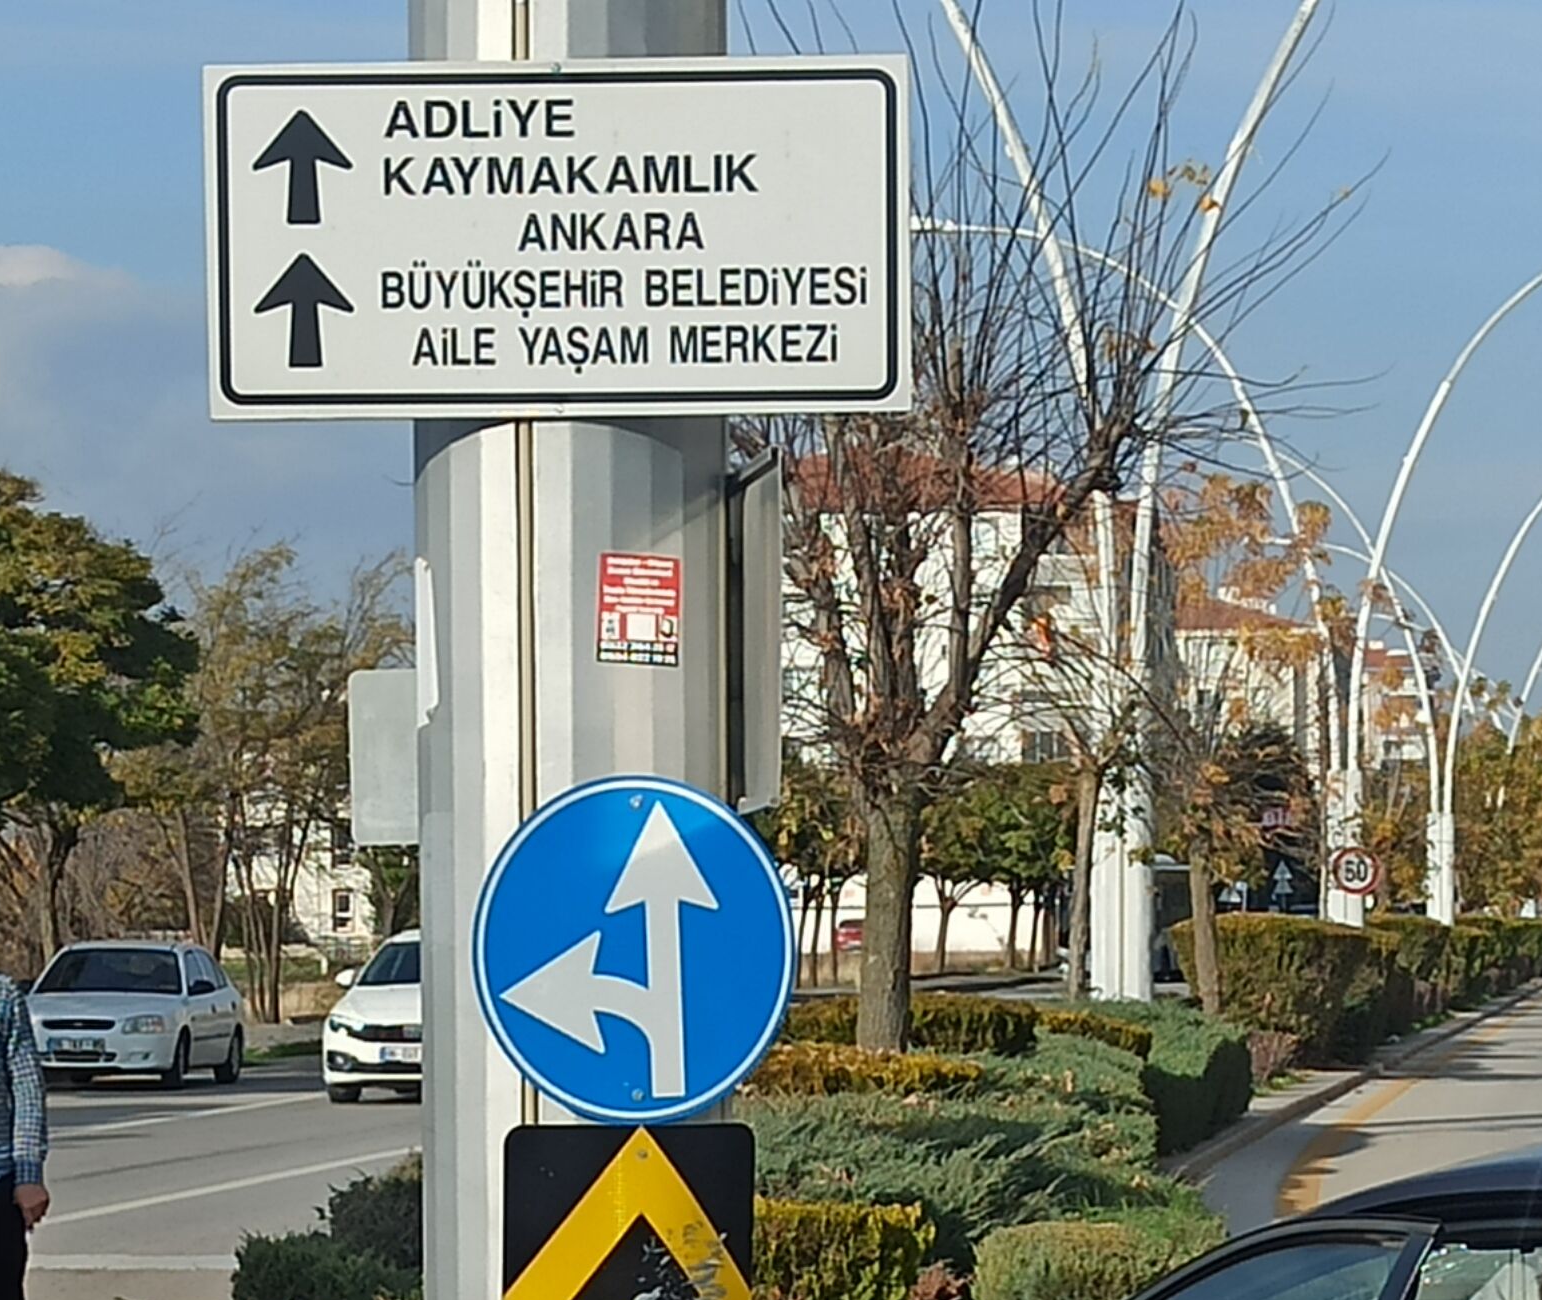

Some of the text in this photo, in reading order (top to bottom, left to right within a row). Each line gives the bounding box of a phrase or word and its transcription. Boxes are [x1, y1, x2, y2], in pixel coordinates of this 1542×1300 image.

[382, 154, 759, 196] KAYMAKAMLIK
[518, 211, 705, 252] ANKARA
[517, 326, 649, 374] YAŞAM
[1345, 859, 1368, 882] 50
